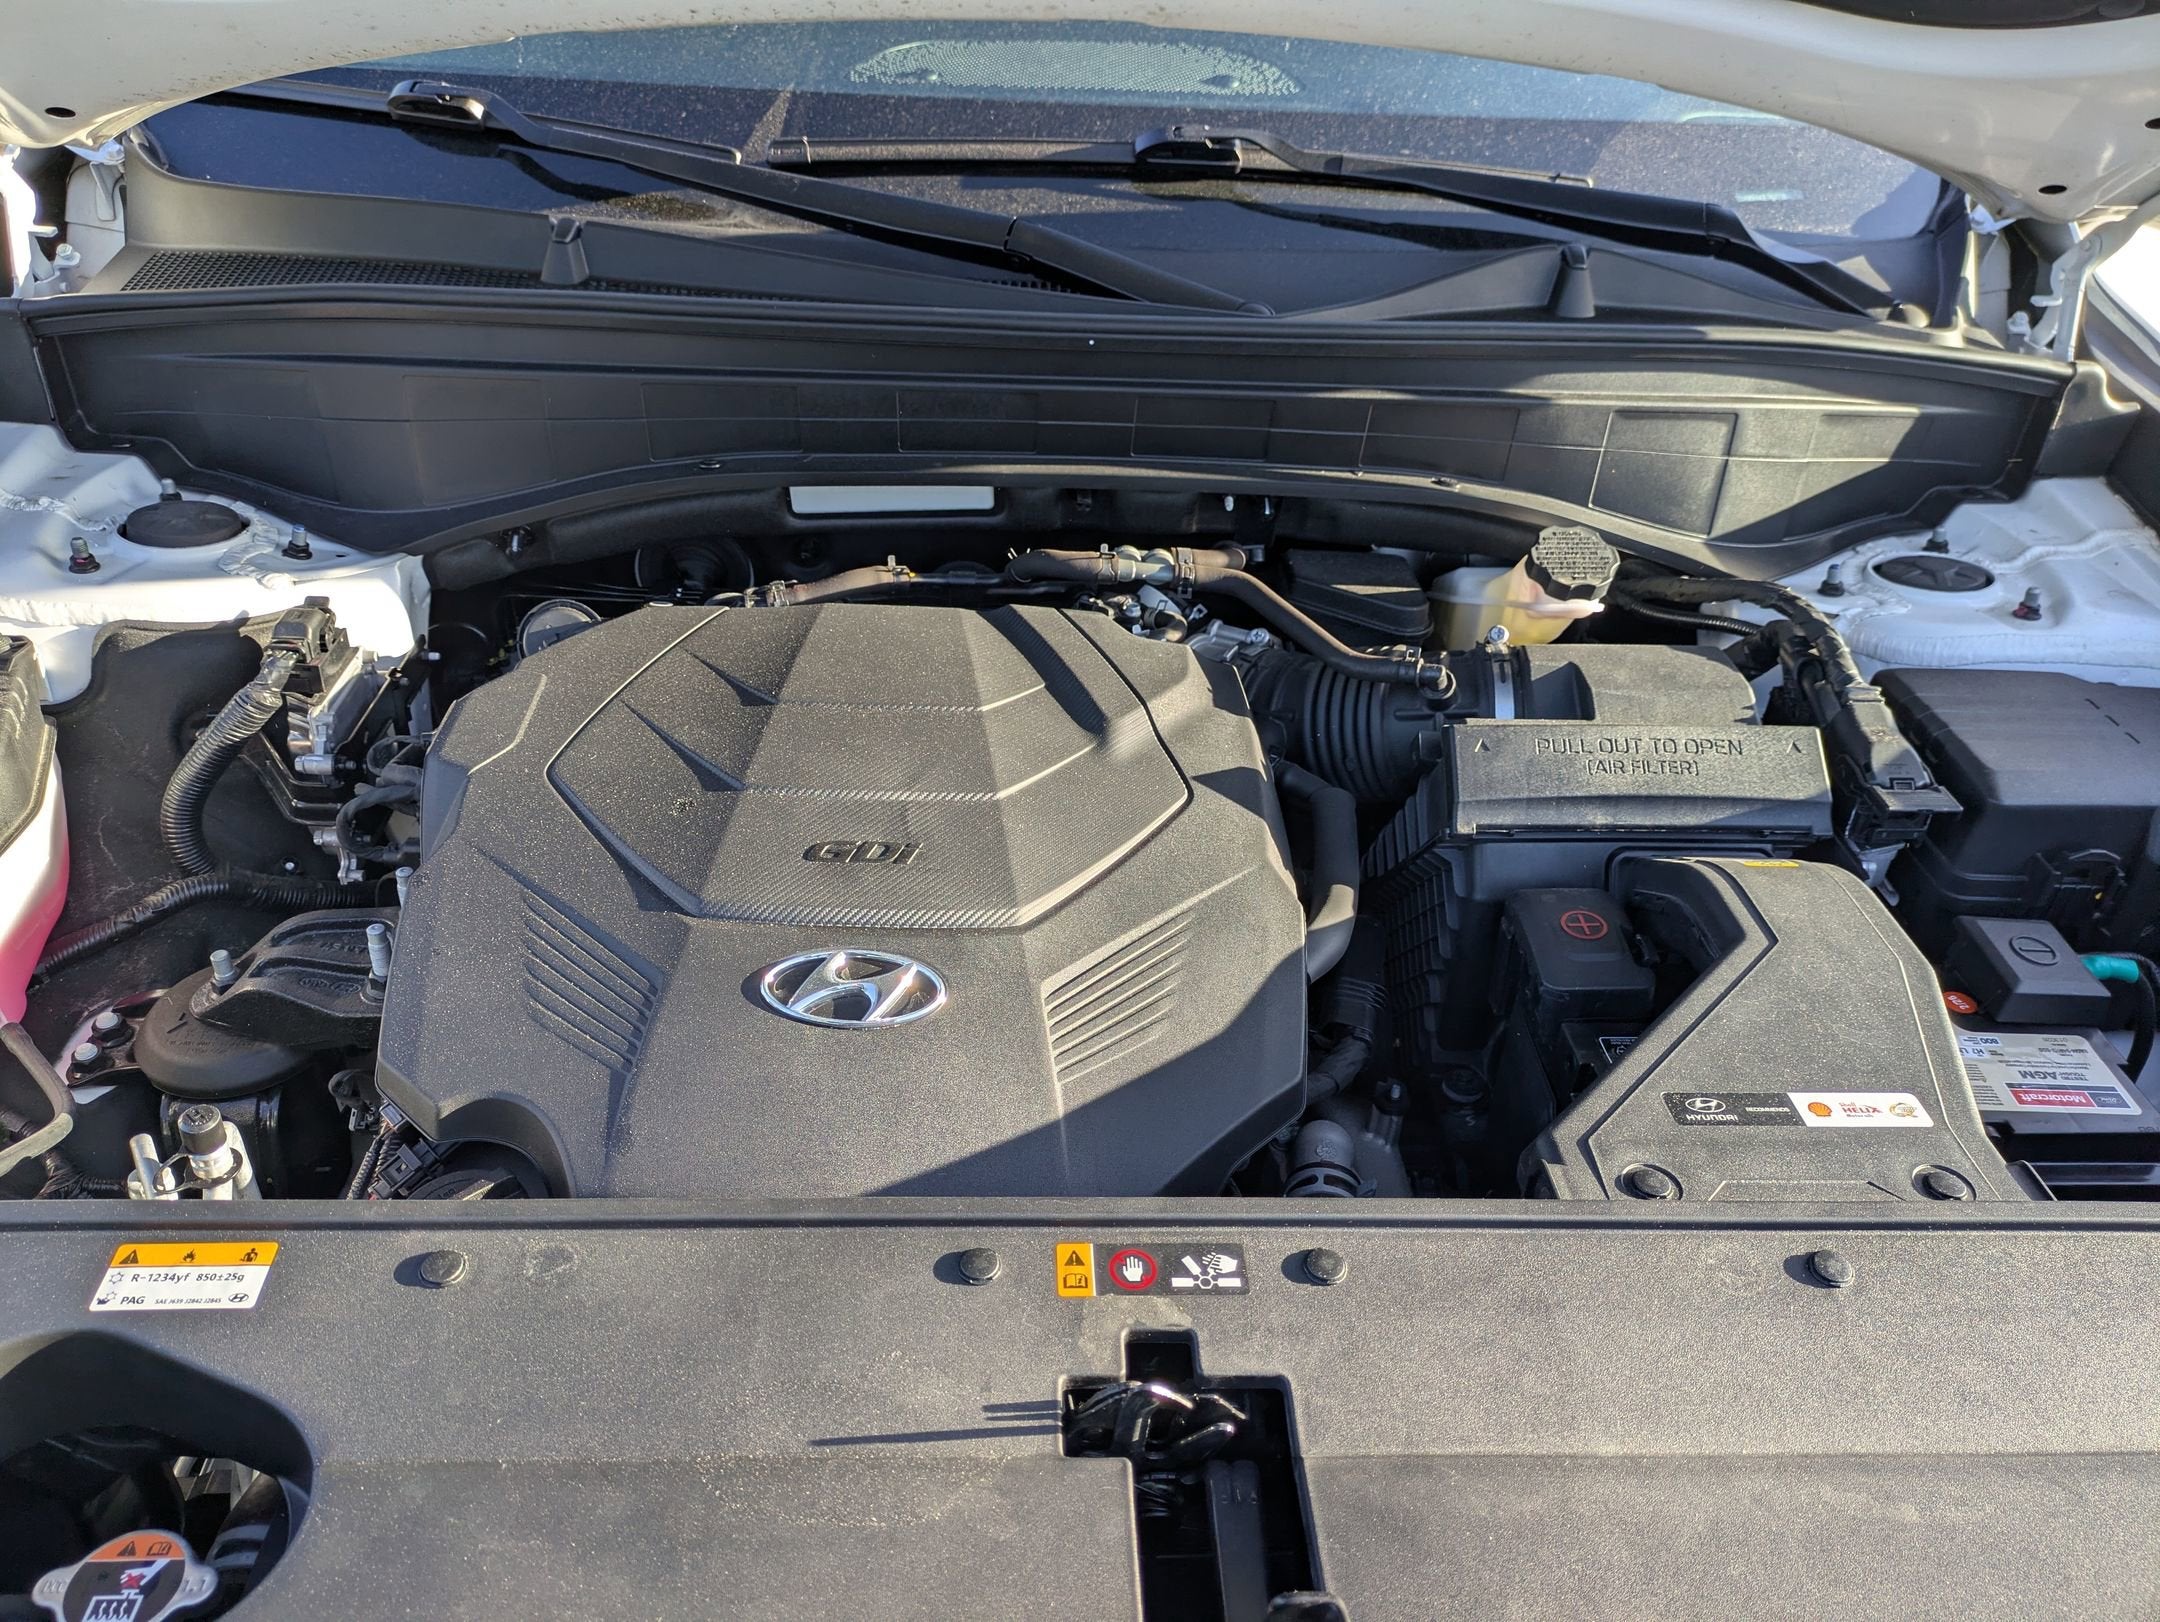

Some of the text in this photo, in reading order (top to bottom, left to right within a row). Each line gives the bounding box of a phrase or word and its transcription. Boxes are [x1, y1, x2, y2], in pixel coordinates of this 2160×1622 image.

[1534, 738, 1744, 756] PULL OUT TO OPEN
[1586, 760, 1700, 776] (AIR FILTER)
[1979, 1037, 2000, 1045] 800
[2018, 1070, 2058, 1081] AGM
[2021, 1092, 2085, 1104] Motorcraft
[1842, 1106, 1883, 1114] HELIX
[1686, 1114, 1739, 1122] HYUNDAI
[131, 1272, 245, 1284] R-1234yf 850±25g
[120, 1296, 146, 1305] PAG
